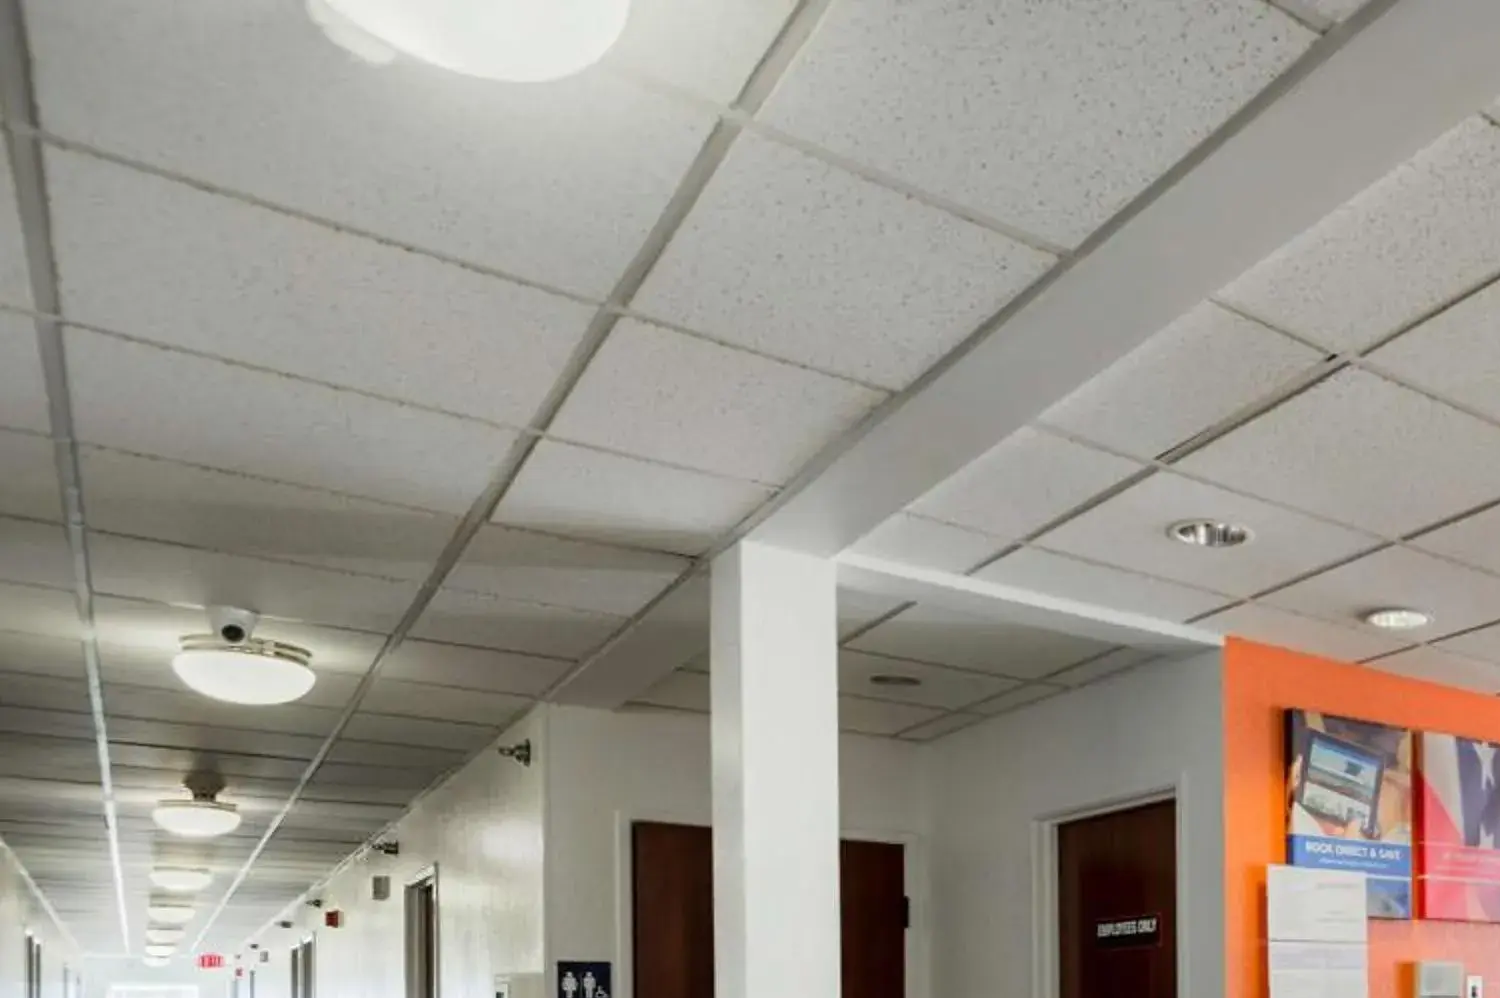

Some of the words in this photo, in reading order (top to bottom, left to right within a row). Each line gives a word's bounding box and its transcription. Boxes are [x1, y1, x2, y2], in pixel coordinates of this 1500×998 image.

[1305, 841, 1334, 854] BOOK
[1335, 845, 1368, 858] DIRECT
[1369, 847, 1377, 859] &
[1379, 848, 1403, 861] SAVE
[1097, 920, 1137, 938] EMPLOYEES
[1137, 918, 1157, 934] ONLY
